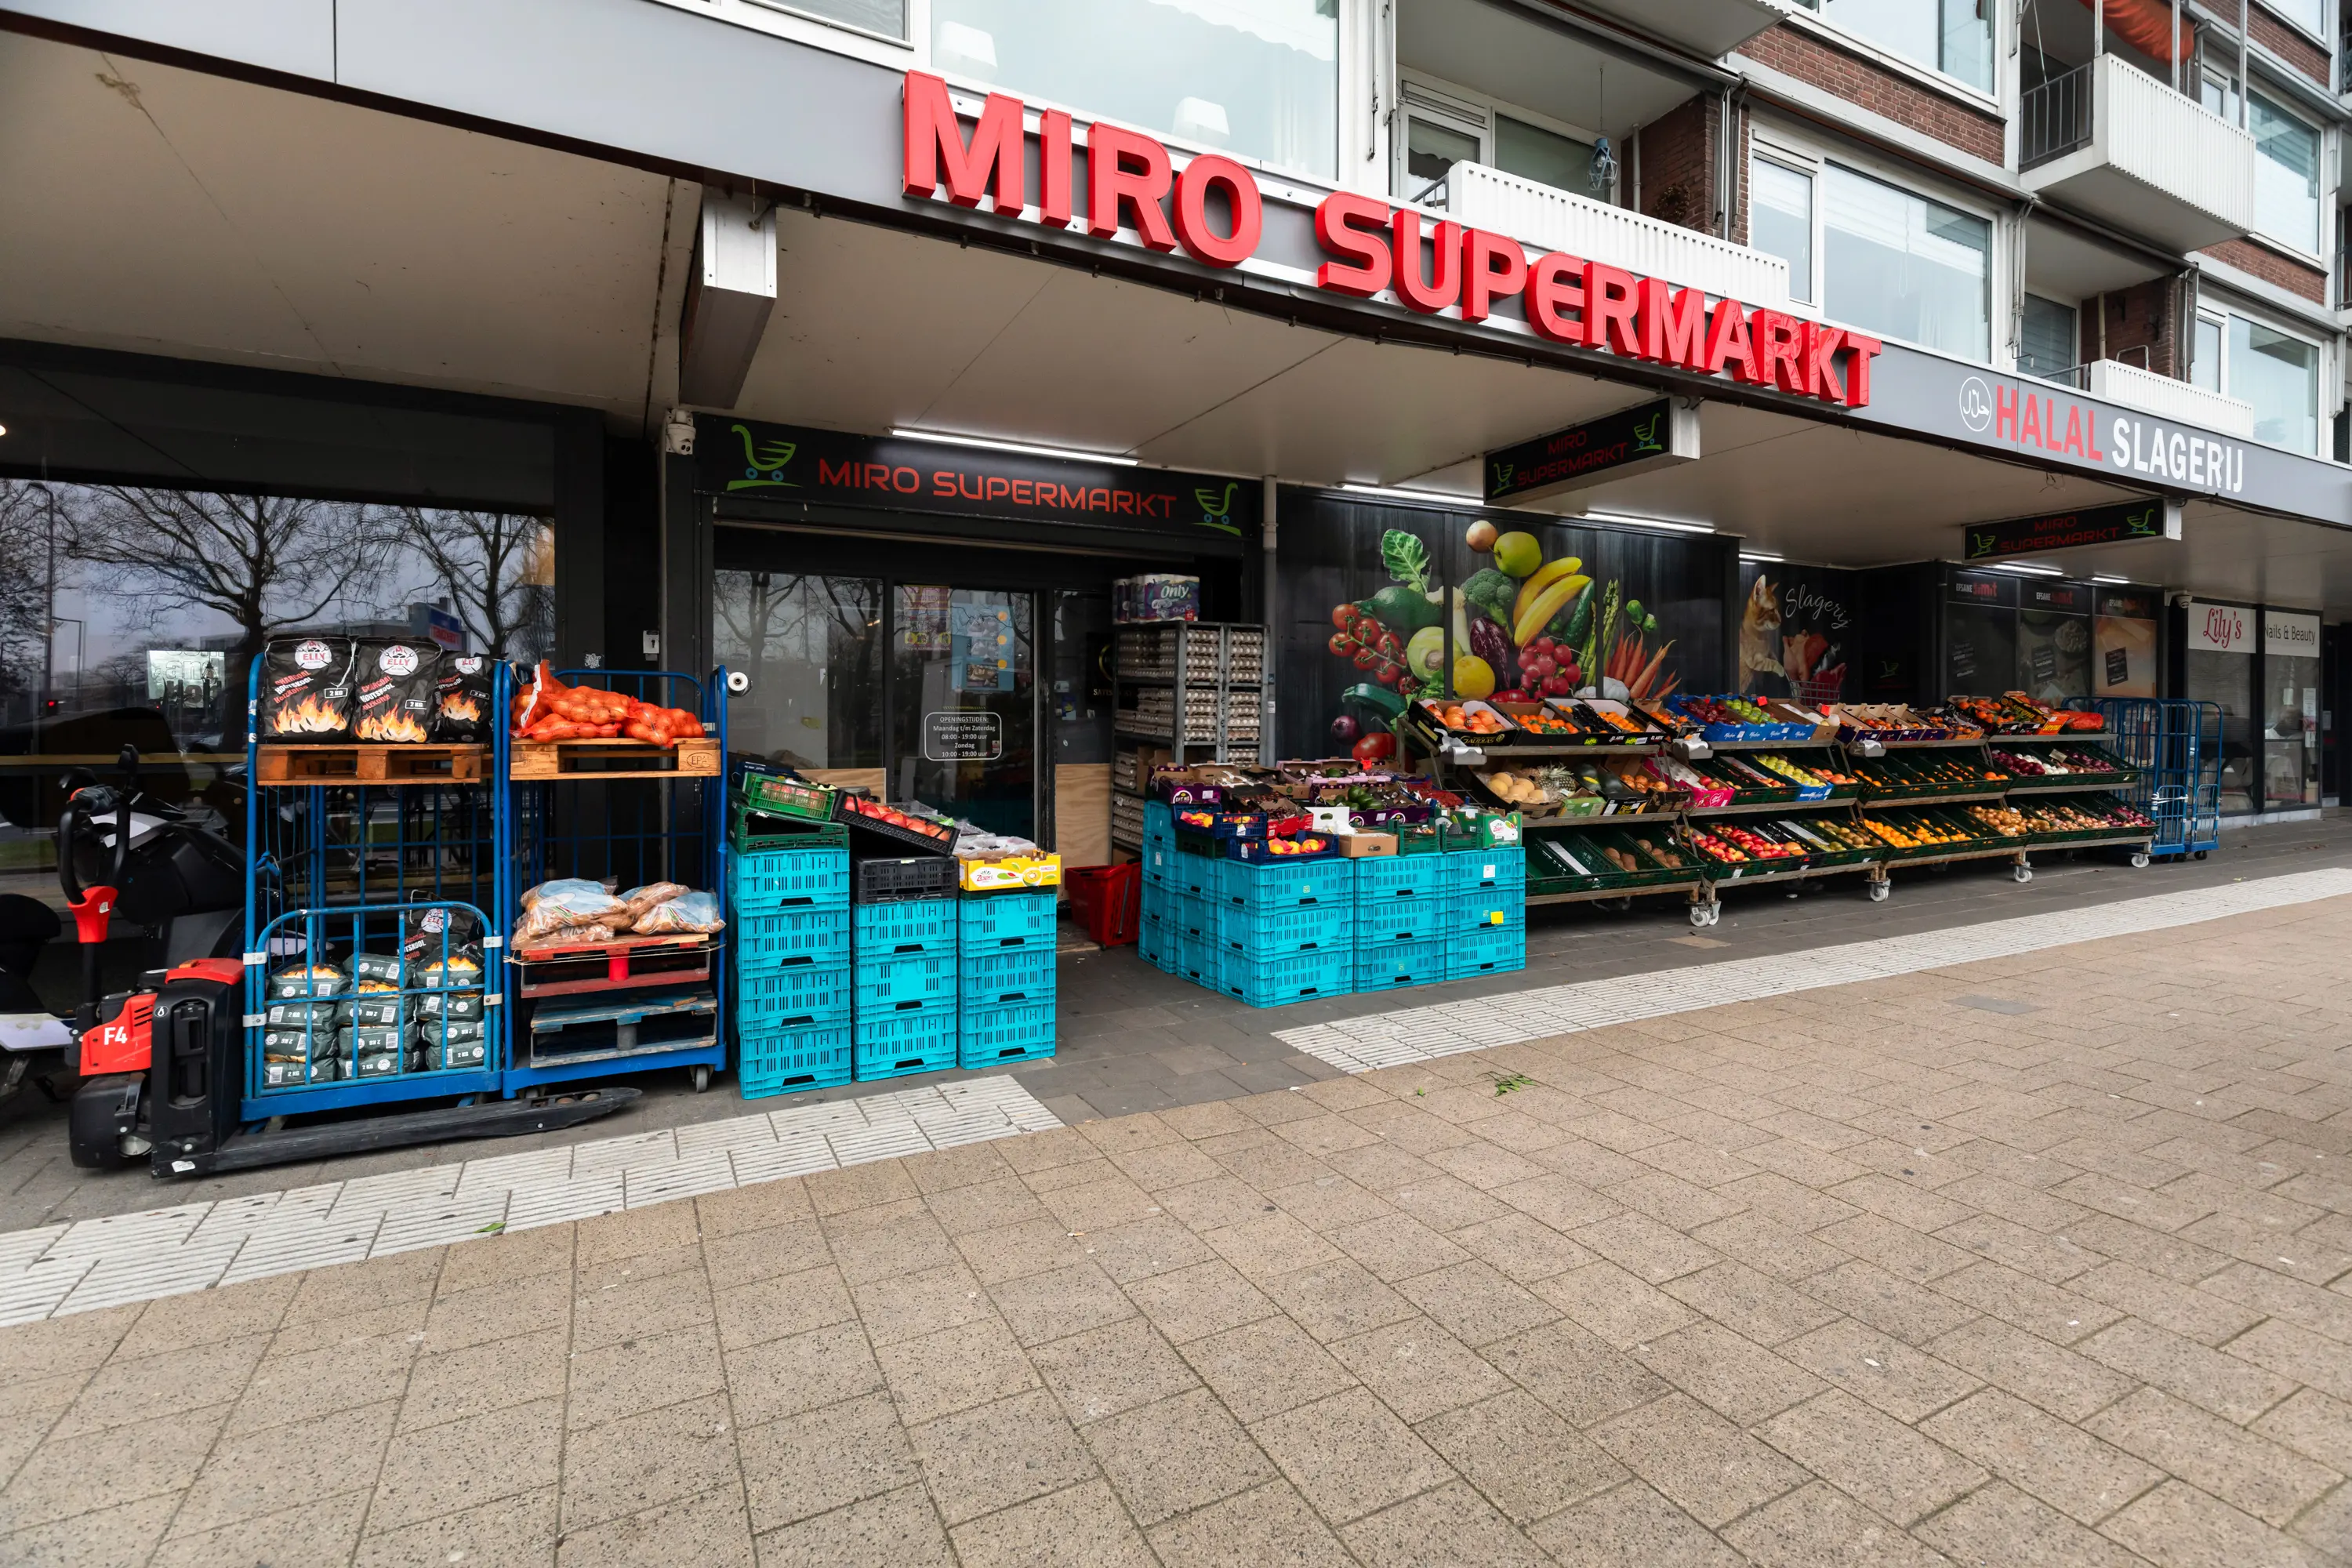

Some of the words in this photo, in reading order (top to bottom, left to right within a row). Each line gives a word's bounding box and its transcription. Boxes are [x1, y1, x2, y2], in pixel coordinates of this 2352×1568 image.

[902, 69, 1263, 270] MIRO
[1313, 189, 1882, 408] SUPERMARKT
[1547, 430, 1587, 456] MIRO
[1996, 384, 2103, 463] HALAL
[2111, 417, 2244, 493] SLAGERIJ
[1517, 442, 1628, 486] SUPERMARKT
[818, 457, 920, 494] MIRO
[933, 470, 1178, 519] SUPERMARKT
[2034, 515, 2077, 534] MIRO
[1999, 527, 2121, 553] SUPERMARKT
[1160, 584, 1189, 598] Only
[1785, 583, 1852, 630] Slagerij
[2202, 608, 2242, 648] Lily's
[2265, 622, 2282, 640] Nails
[2283, 625, 2289, 639] &
[2292, 626, 2316, 645] Beauty
[359, 682, 396, 703] HOUTSKOOL
[103, 1025, 128, 1046] F4
